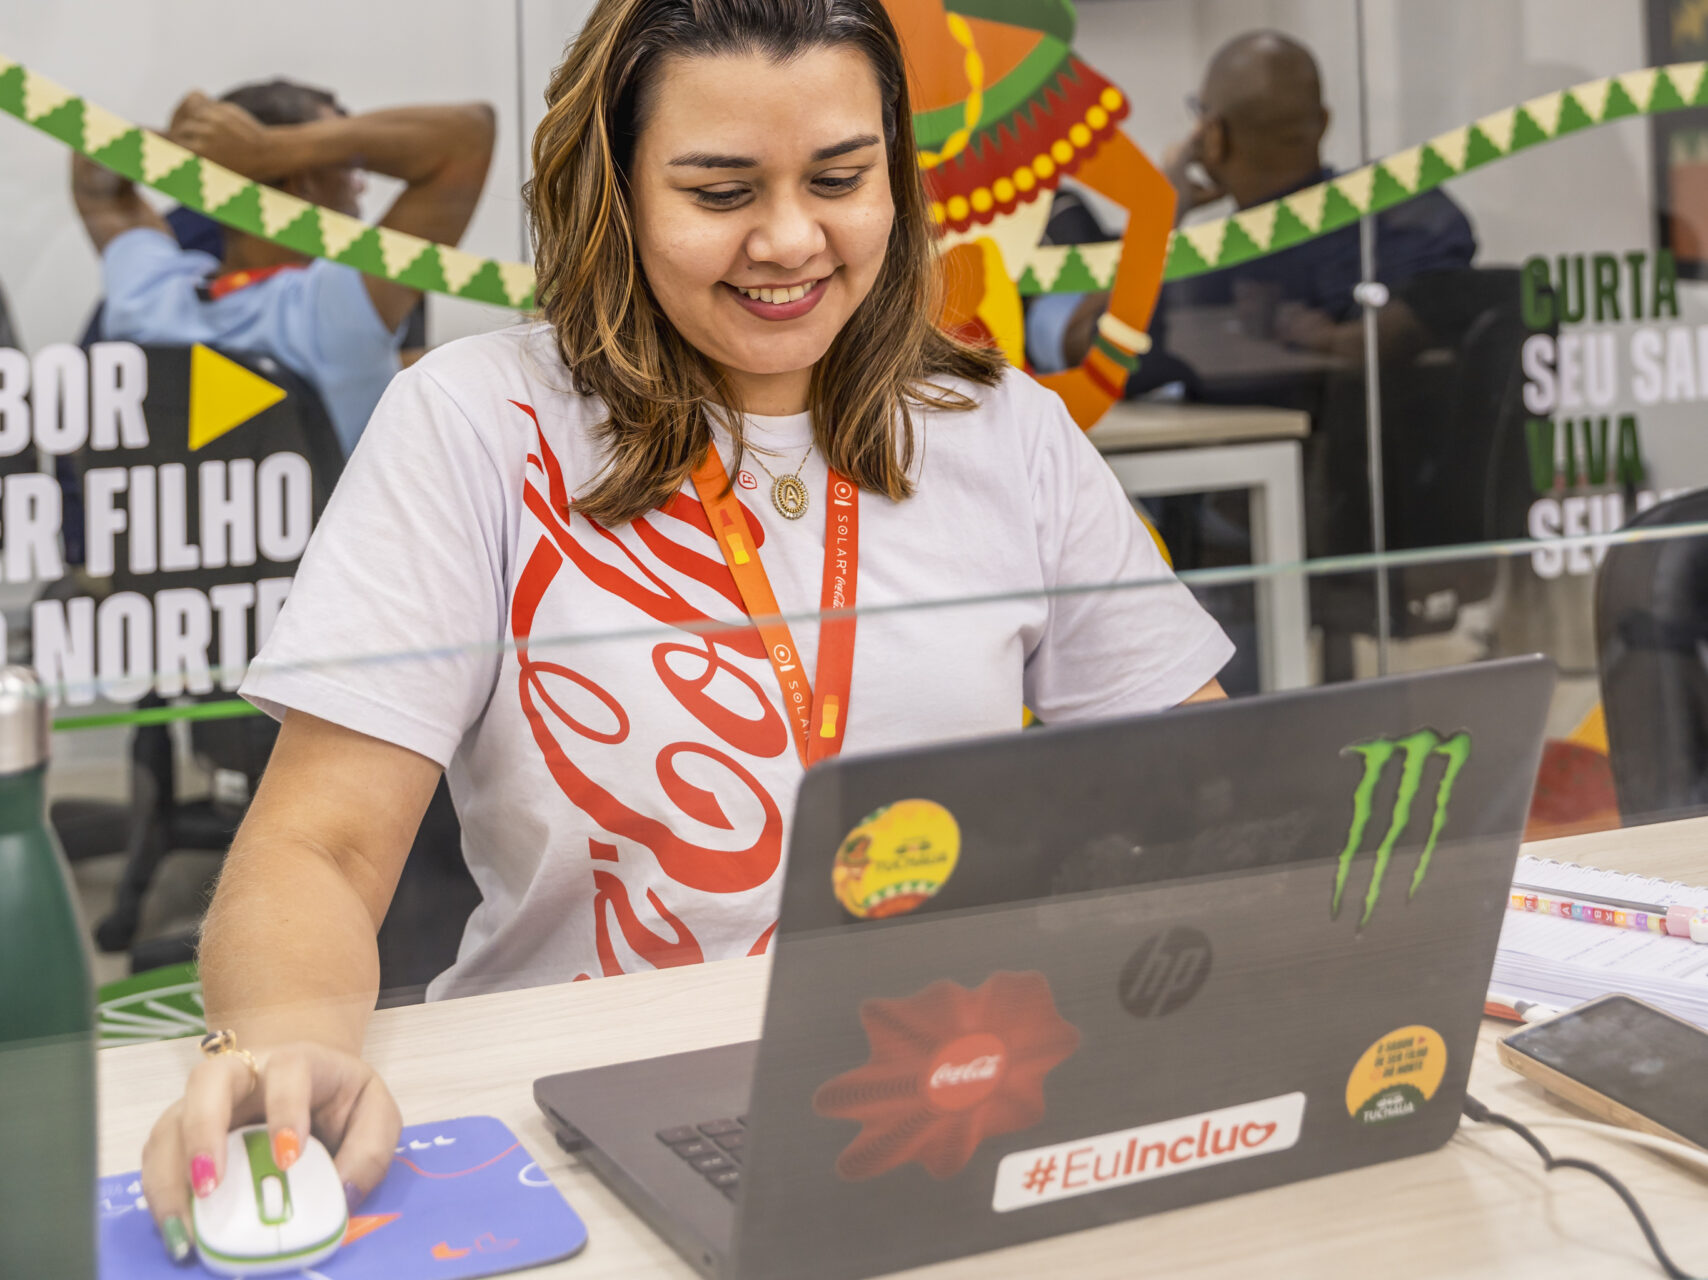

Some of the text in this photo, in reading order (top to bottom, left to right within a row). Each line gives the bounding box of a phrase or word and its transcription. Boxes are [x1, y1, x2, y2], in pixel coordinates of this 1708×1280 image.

[1521, 248, 1680, 330] CURTA
[1521, 332, 1616, 416] SEU
[1525, 414, 1645, 493] VIVA
[84, 451, 313, 579] FILHO
[836, 514, 849, 569] SOLAR
